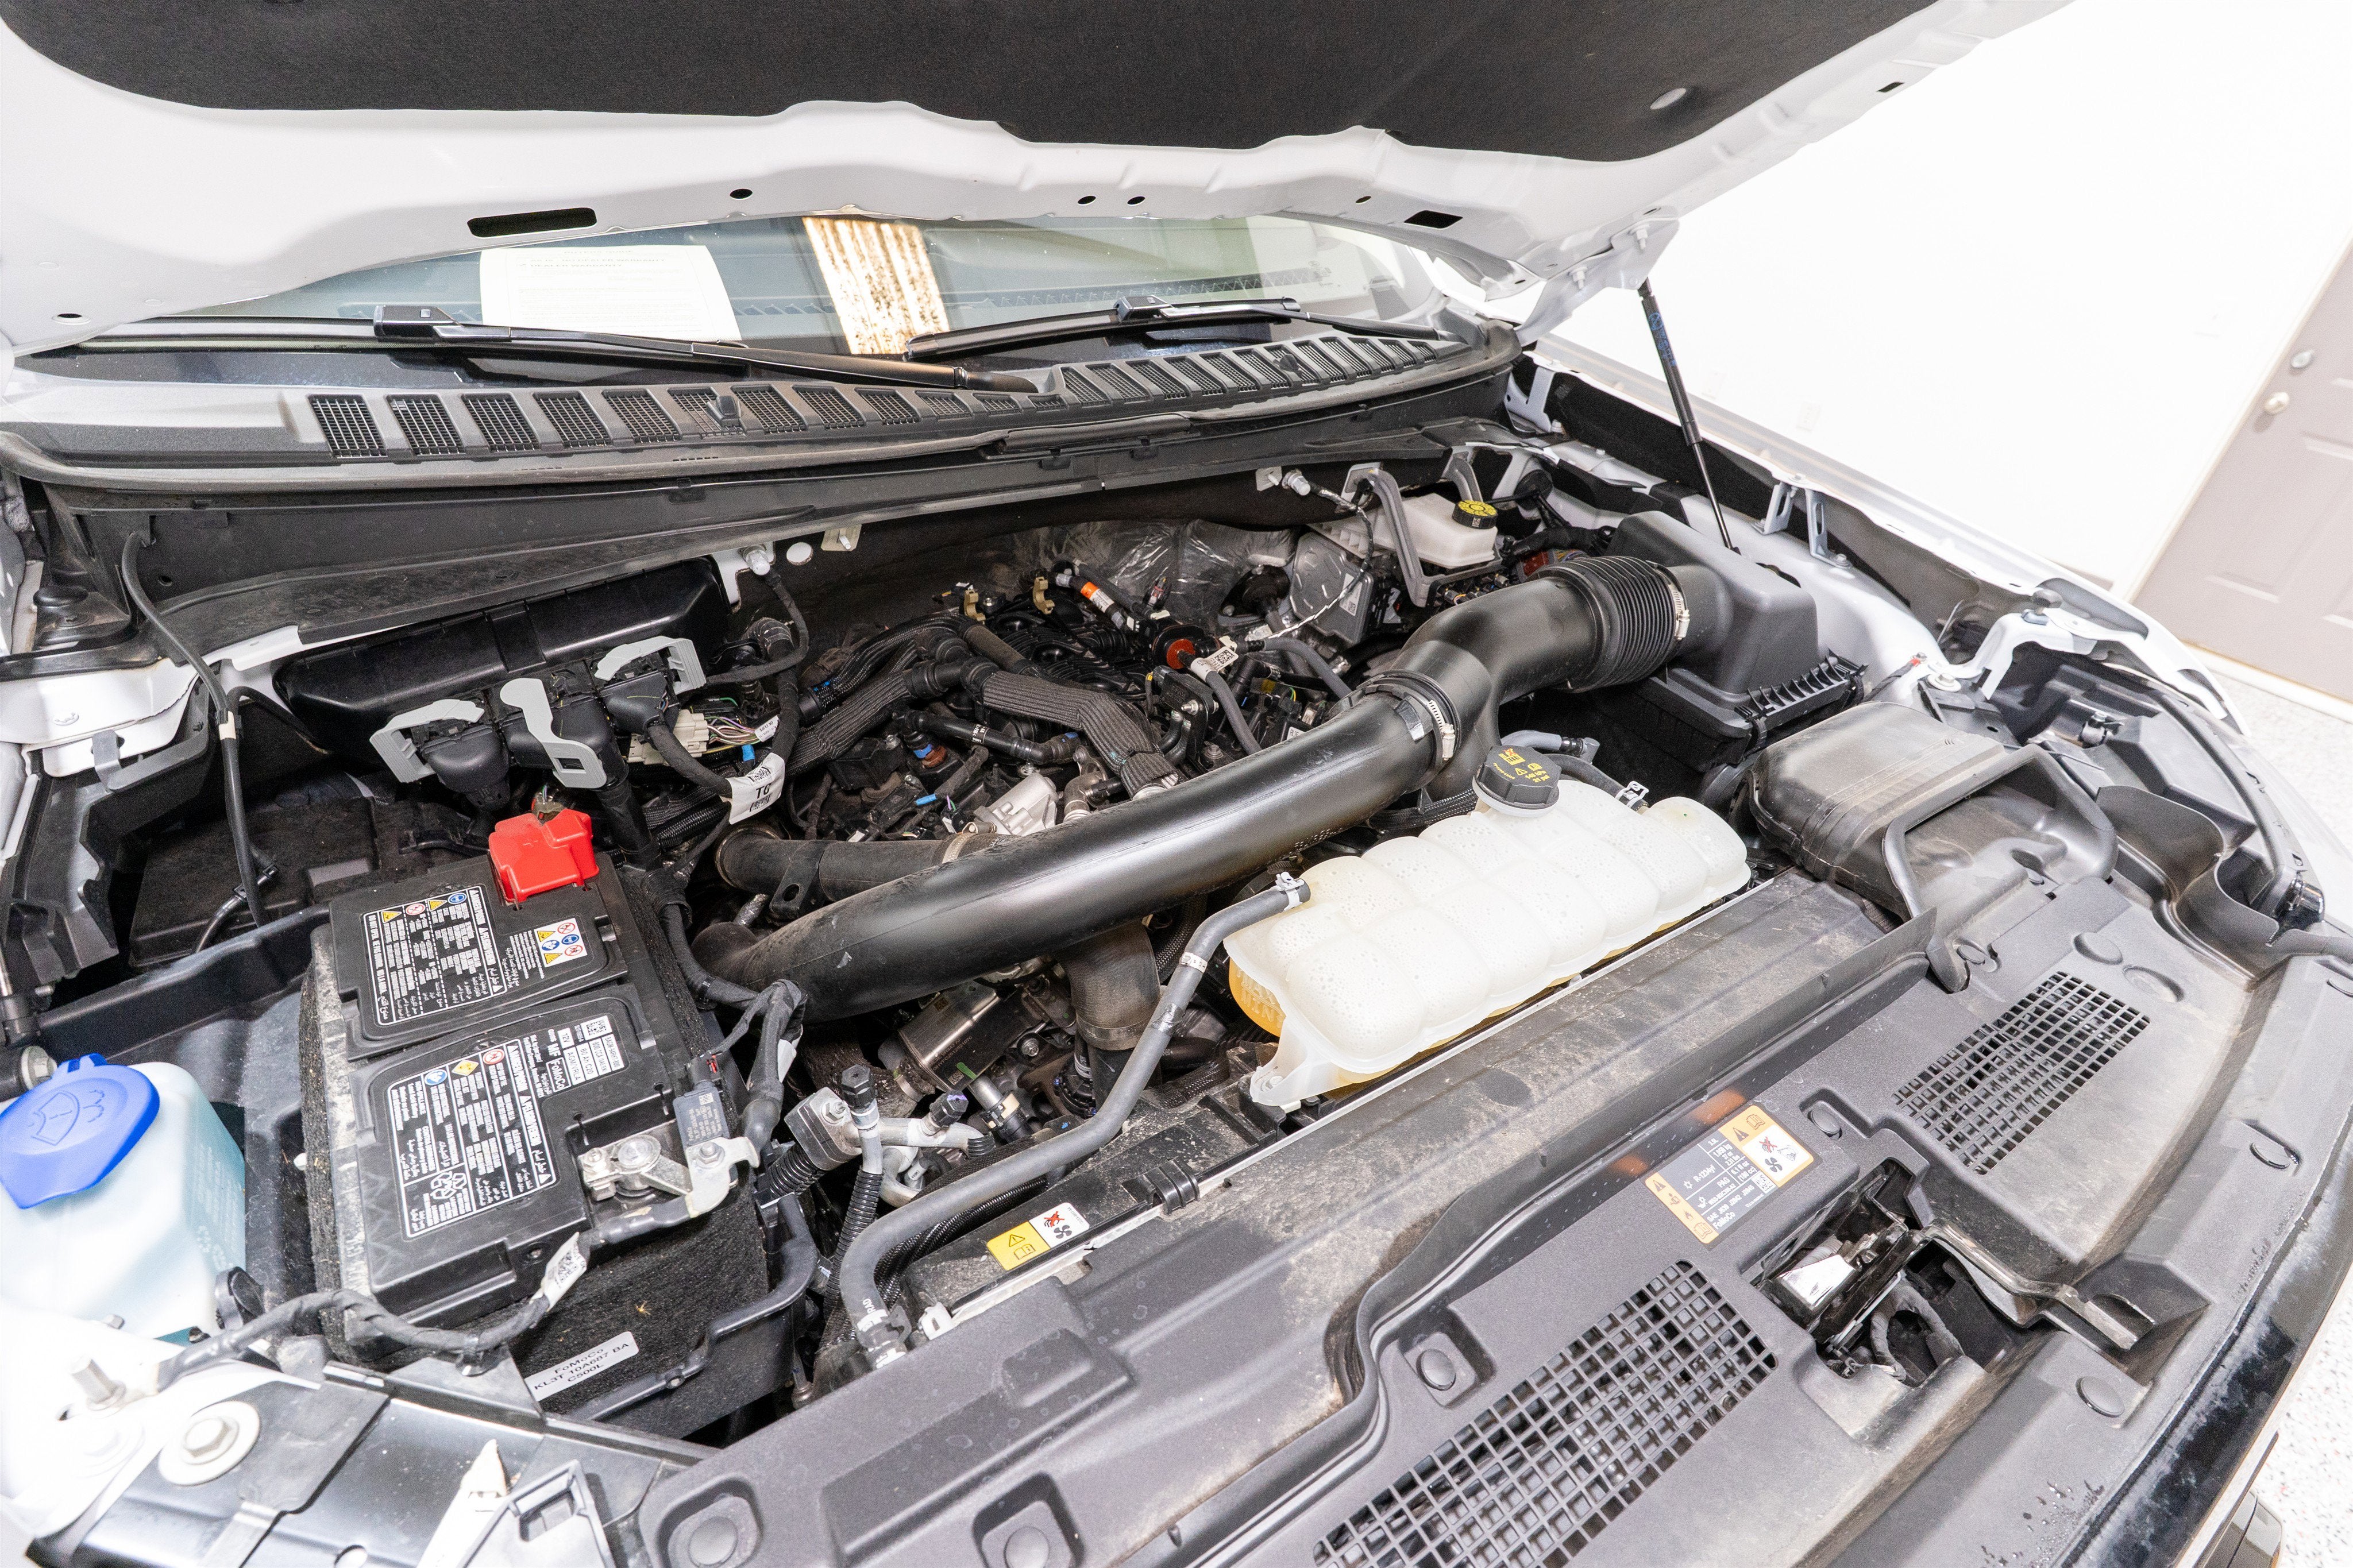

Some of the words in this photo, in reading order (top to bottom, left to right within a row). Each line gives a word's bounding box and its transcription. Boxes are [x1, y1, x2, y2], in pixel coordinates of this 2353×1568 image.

[562, 1033, 570, 1042] 12V
[547, 1043, 560, 1056] MF
[550, 1060, 565, 1088] FoMoCo
[568, 1052, 580, 1080] AGM/VRLA
[585, 1064, 593, 1074] C20
[1693, 1164, 1715, 1181] R-1234yf
[1730, 1167, 1739, 1175] 6.1
[1717, 1177, 1730, 1187] PAG
[1707, 1212, 1718, 1221] SAE
[1718, 1204, 1729, 1214] J639
[1729, 1195, 1741, 1206] J2842
[1742, 1184, 1754, 1195] J2845
[1712, 1212, 1735, 1229] FoMoCo
[534, 1374, 562, 1389] KL3T
[570, 1353, 607, 1373] 10A687
[612, 1343, 628, 1352] BA
[554, 1349, 603, 1373] FoMoCo
[568, 1365, 599, 1381] C500L
